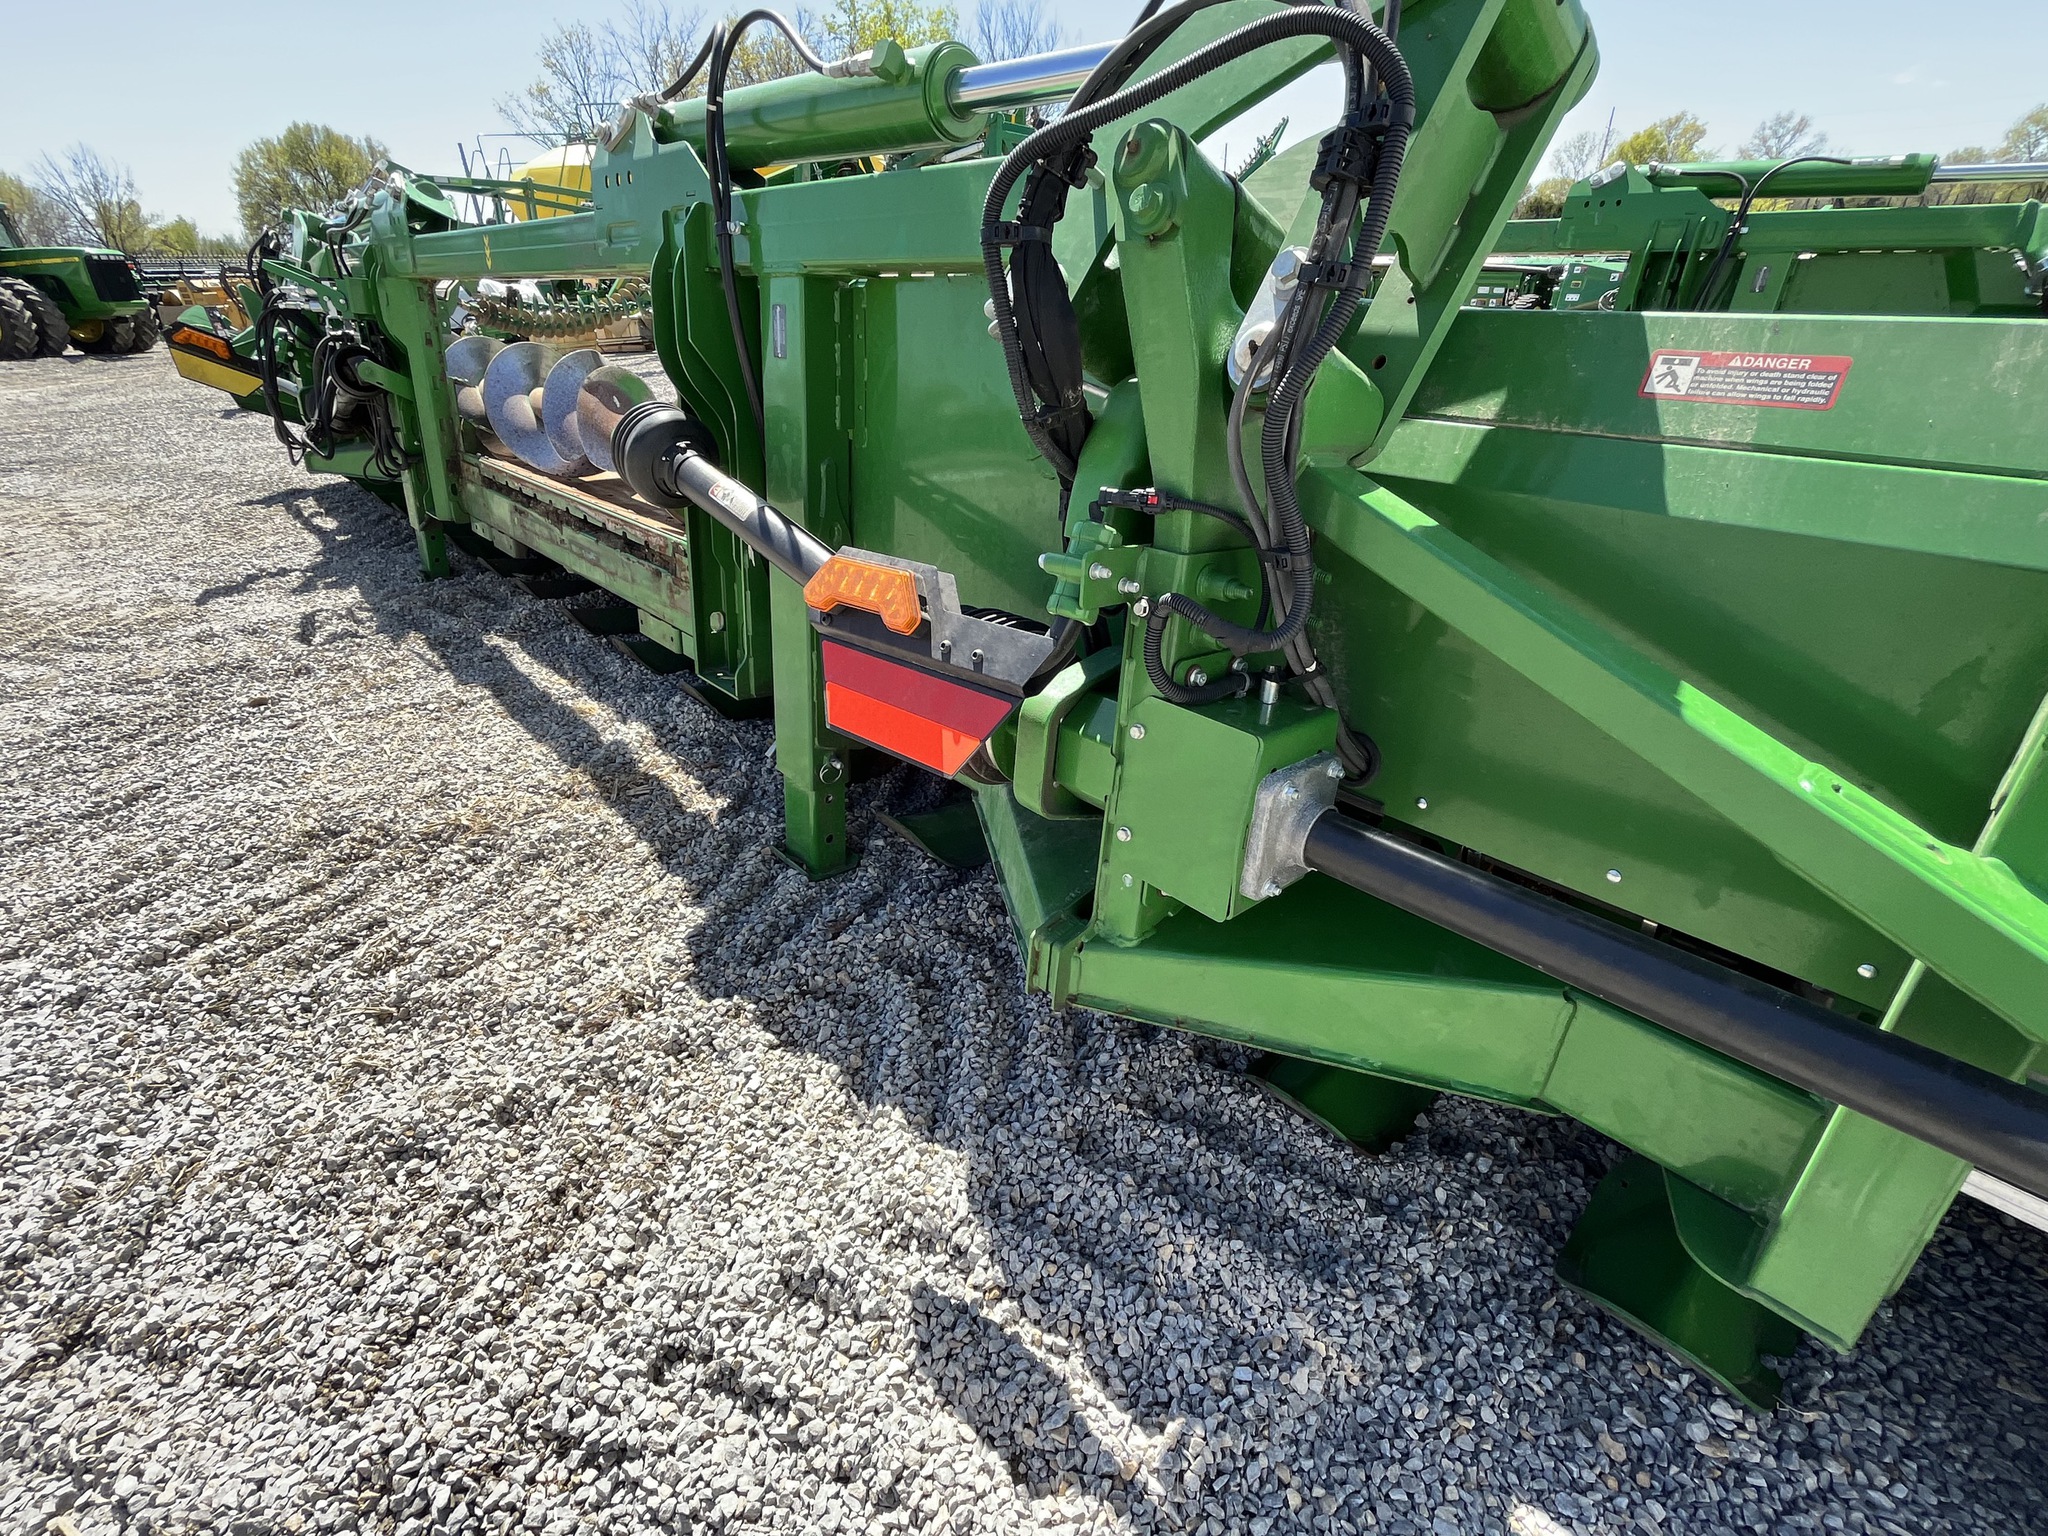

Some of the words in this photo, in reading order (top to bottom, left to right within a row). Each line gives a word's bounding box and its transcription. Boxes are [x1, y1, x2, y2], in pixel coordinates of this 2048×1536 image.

[1287, 305, 1300, 334] exceeds
[1295, 289, 1306, 302] SAE
[1742, 356, 1812, 370] DANGER
[1735, 384, 1780, 392] Mechanical
[1791, 387, 1830, 396] hydraulic
[1784, 380, 1806, 388] being
[1687, 388, 1711, 396] failure
[1796, 396, 1827, 405] rapidly.
